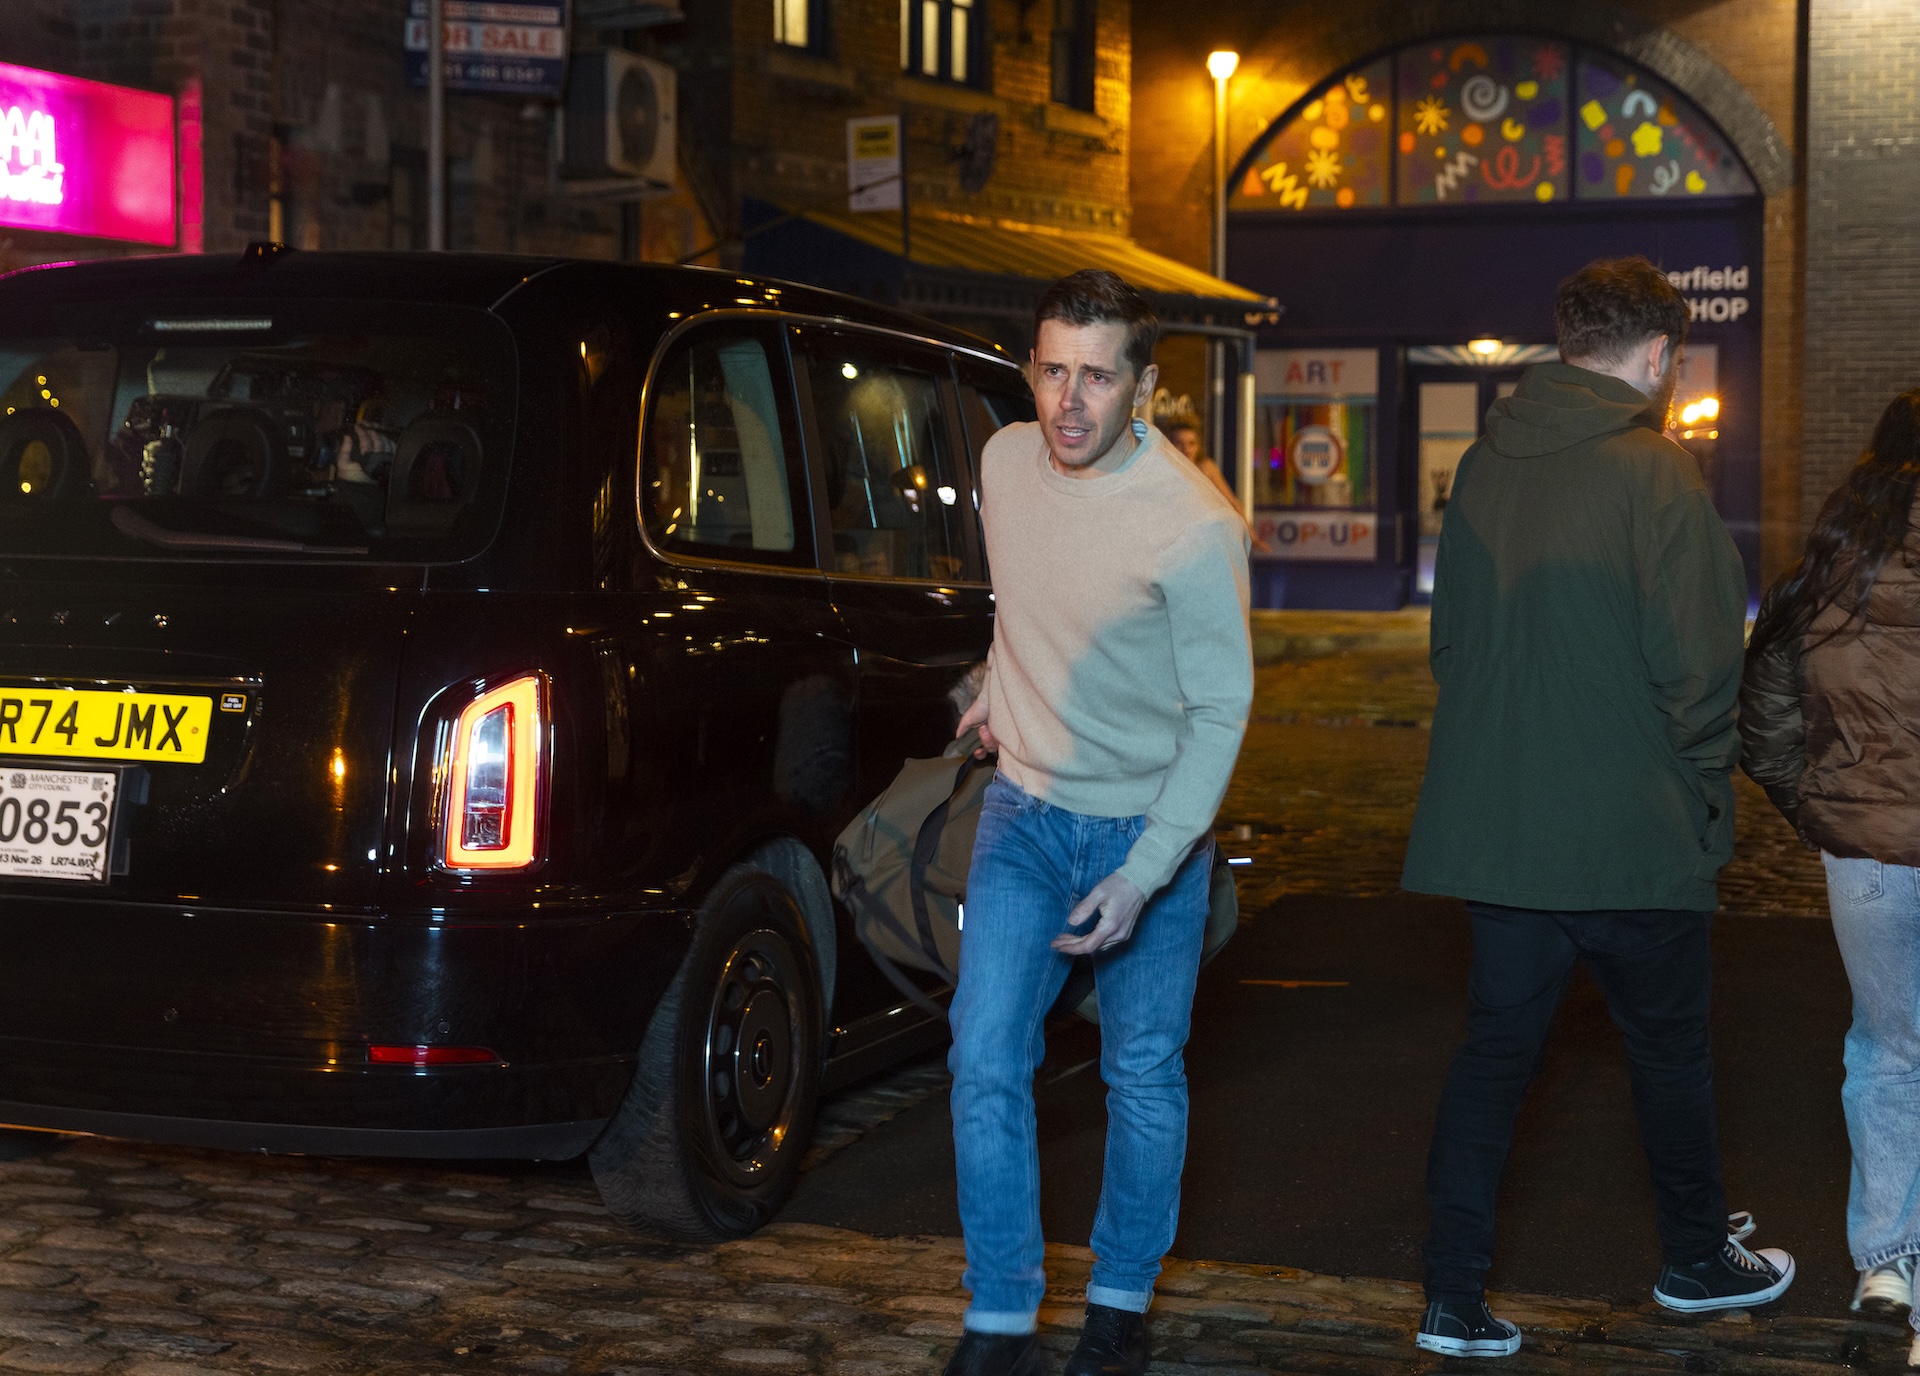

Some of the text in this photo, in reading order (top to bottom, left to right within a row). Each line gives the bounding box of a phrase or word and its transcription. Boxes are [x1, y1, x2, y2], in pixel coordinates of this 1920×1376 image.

[483, 26, 555, 52] SALE
[1666, 265, 1749, 291] erfield
[1686, 297, 1749, 322] HOP
[1285, 360, 1345, 385] ART
[1258, 521, 1369, 546] POP-UP
[0, 698, 189, 752] R74 JMX
[29, 773, 89, 785] MANCHESTER
[0, 797, 107, 848] 0853
[11, 854, 29, 864] Nov
[30, 855, 42, 865] 26
